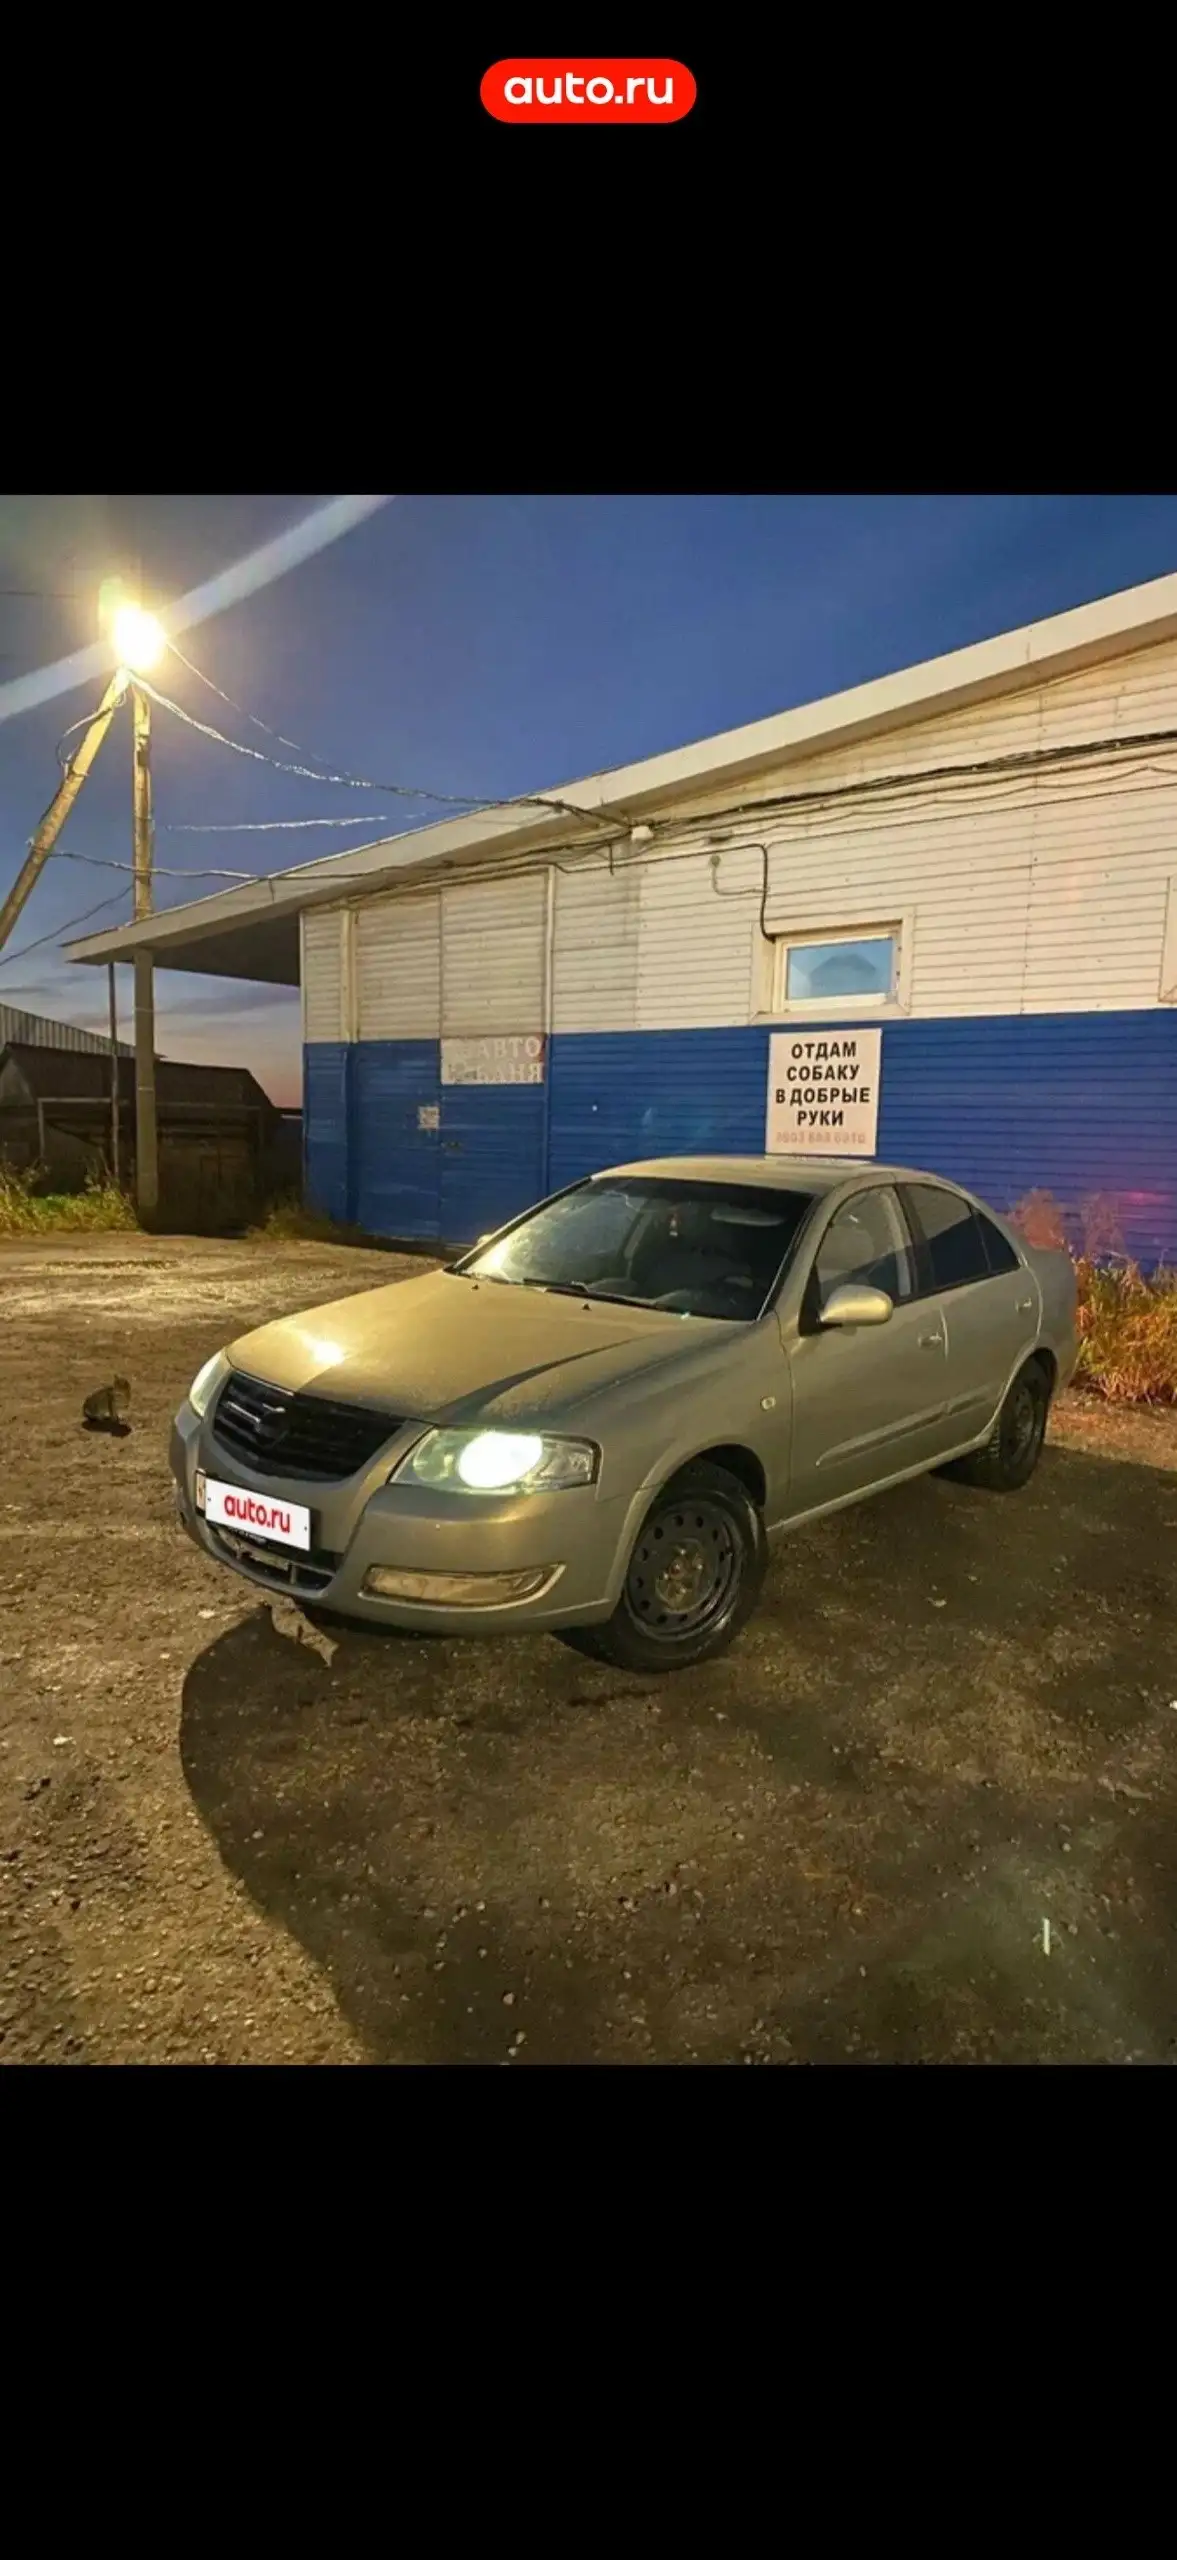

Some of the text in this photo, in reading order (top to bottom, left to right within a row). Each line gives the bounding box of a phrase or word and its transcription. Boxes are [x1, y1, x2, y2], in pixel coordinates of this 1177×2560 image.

[791, 1041, 857, 1061] ОТДАМ
[786, 1064, 860, 1081] СОБАКУ
[775, 1087, 871, 1106] В ДОБРЫЕ
[797, 1110, 844, 1126] РУКИ
